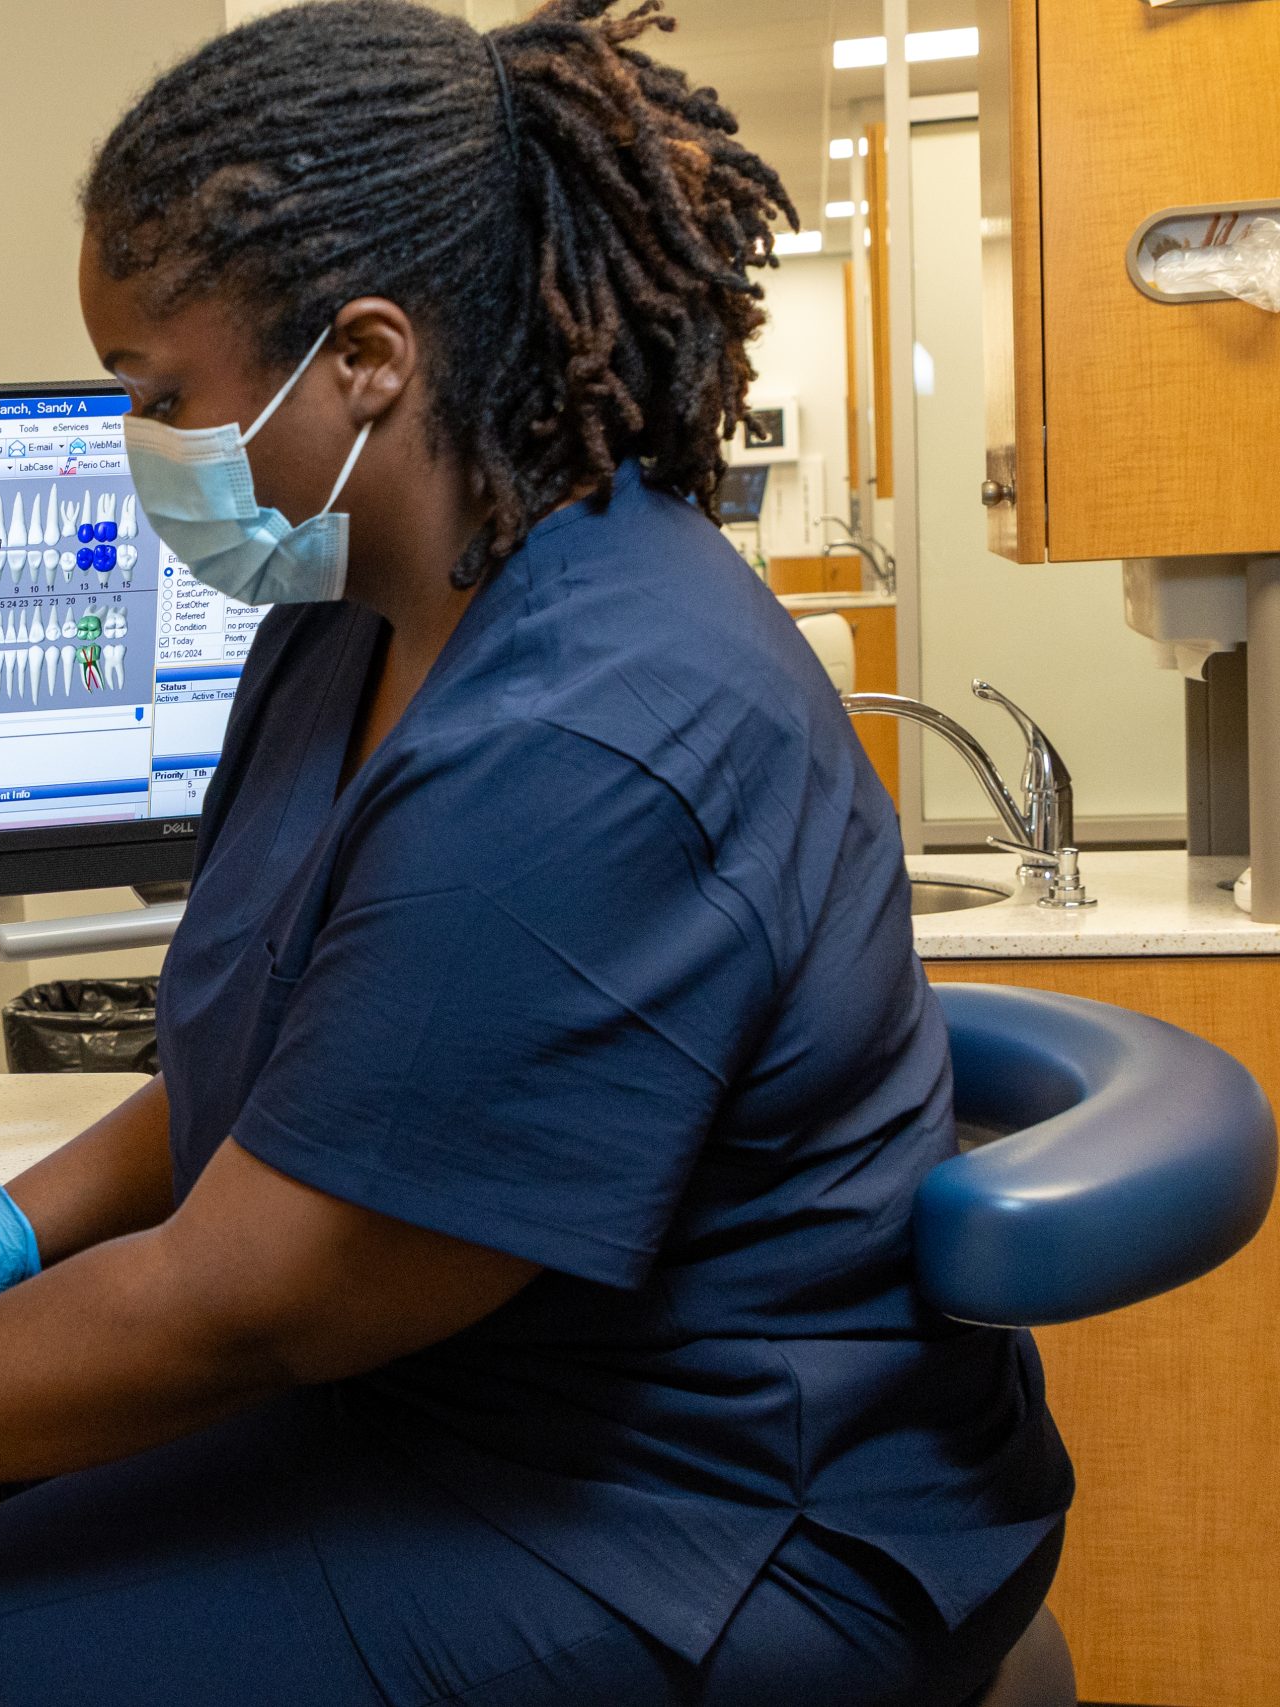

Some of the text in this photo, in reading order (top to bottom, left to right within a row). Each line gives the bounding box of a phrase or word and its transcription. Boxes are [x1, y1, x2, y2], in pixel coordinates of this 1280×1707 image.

[37, 401, 73, 415] Sandy
[78, 401, 87, 412] A
[19, 424, 39, 433] Tools
[53, 423, 89, 432] eServices
[102, 421, 122, 430] Alerts
[28, 443, 52, 452] E-mail
[89, 440, 122, 449] WebMail
[19, 462, 54, 472] LabCase
[78, 460, 120, 469] Perio Chart
[14, 586, 20, 594] 9
[80, 583, 89, 591] 13
[100, 582, 109, 590] 14
[7, 600, 17, 608] 24
[33, 599, 42, 607] 22
[49, 598, 59, 606] 21
[66, 597, 76, 605] 20
[88, 596, 97, 604] 19
[113, 595, 122, 603] 18
[226, 606, 259, 616] Prognosis
[175, 612, 206, 620] Referred
[174, 624, 207, 632] Condition
[172, 637, 194, 646] Today
[224, 634, 247, 643] Priority
[160, 649, 202, 659] 04/16/2024
[160, 683, 187, 692] Status
[156, 694, 179, 703] Active
[192, 692, 215, 700] Active
[155, 769, 207, 780] Priority Tth
[187, 780, 193, 788] 5
[12, 790, 30, 800] Info
[188, 790, 196, 798] 19
[163, 822, 194, 835] DELL
